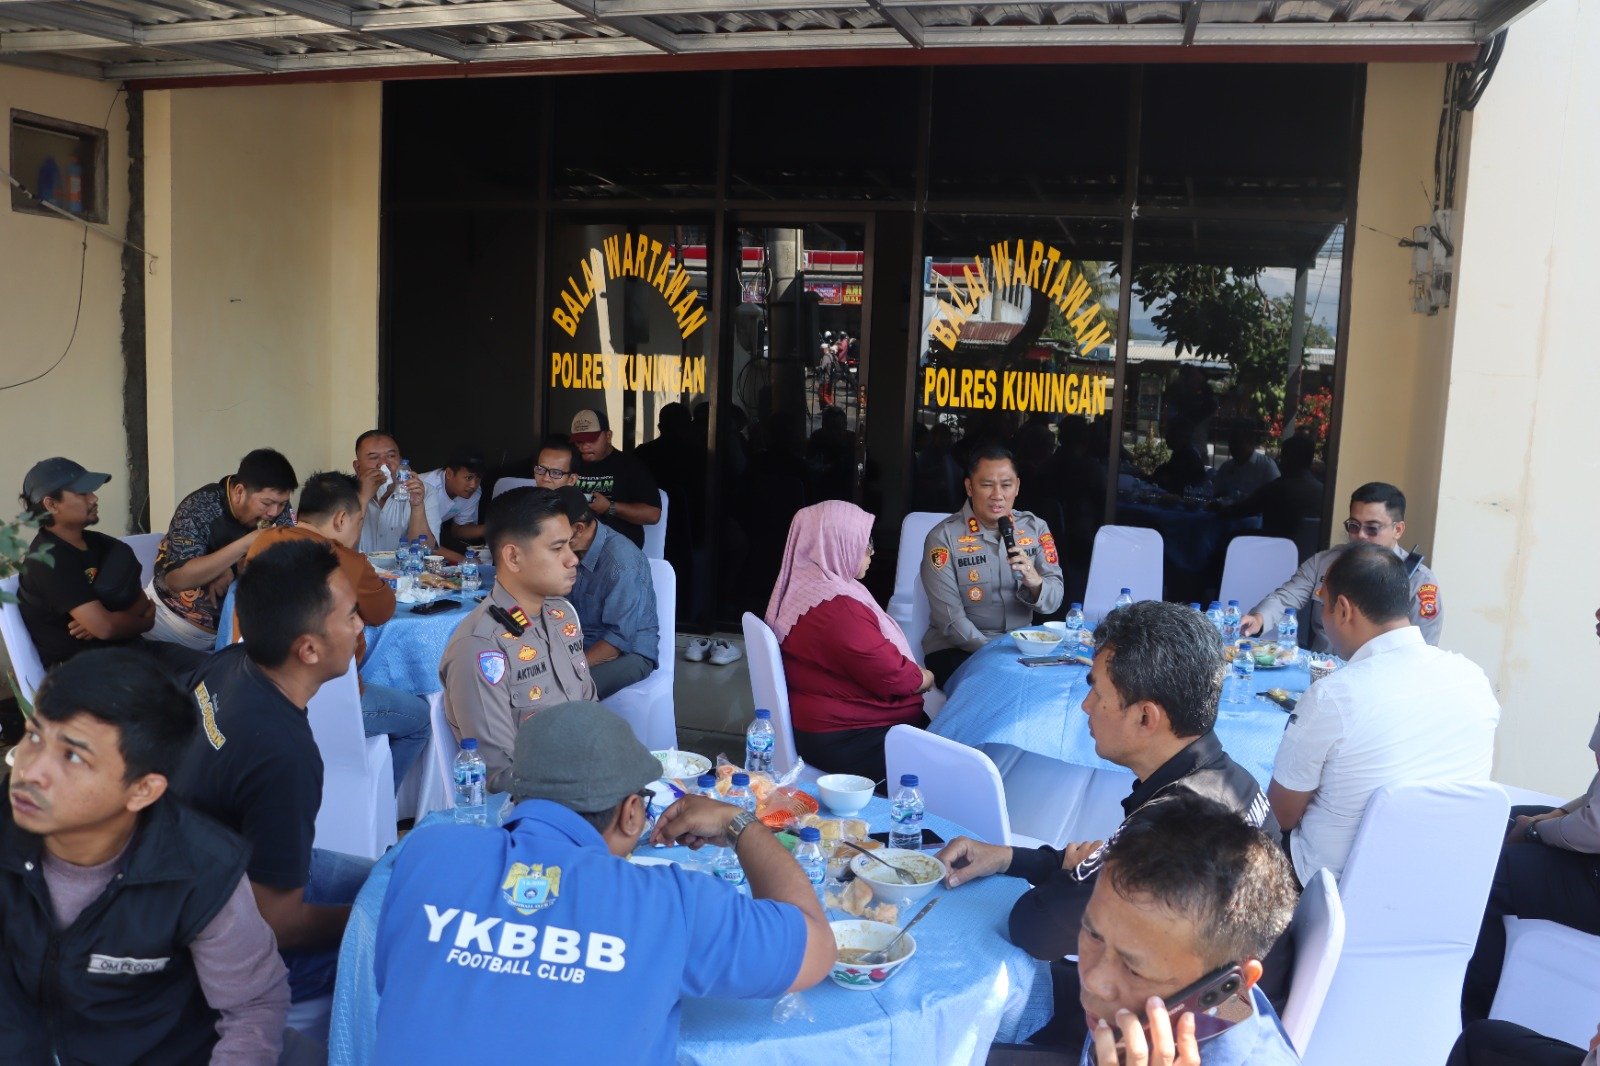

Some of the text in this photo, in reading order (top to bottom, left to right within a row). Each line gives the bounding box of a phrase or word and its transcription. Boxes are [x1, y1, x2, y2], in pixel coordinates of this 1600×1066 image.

[603, 233, 708, 340] WARTAWAN
[928, 238, 1111, 357] BALAI WARTAWAN
[551, 352, 705, 394] POLRES KUNINGAN
[924, 367, 1107, 416] POLRES KUNINGAN
[957, 554, 987, 567] BELLEN
[423, 903, 626, 972] YKBBB
[446, 949, 586, 984] FOOTBALL CLUB
